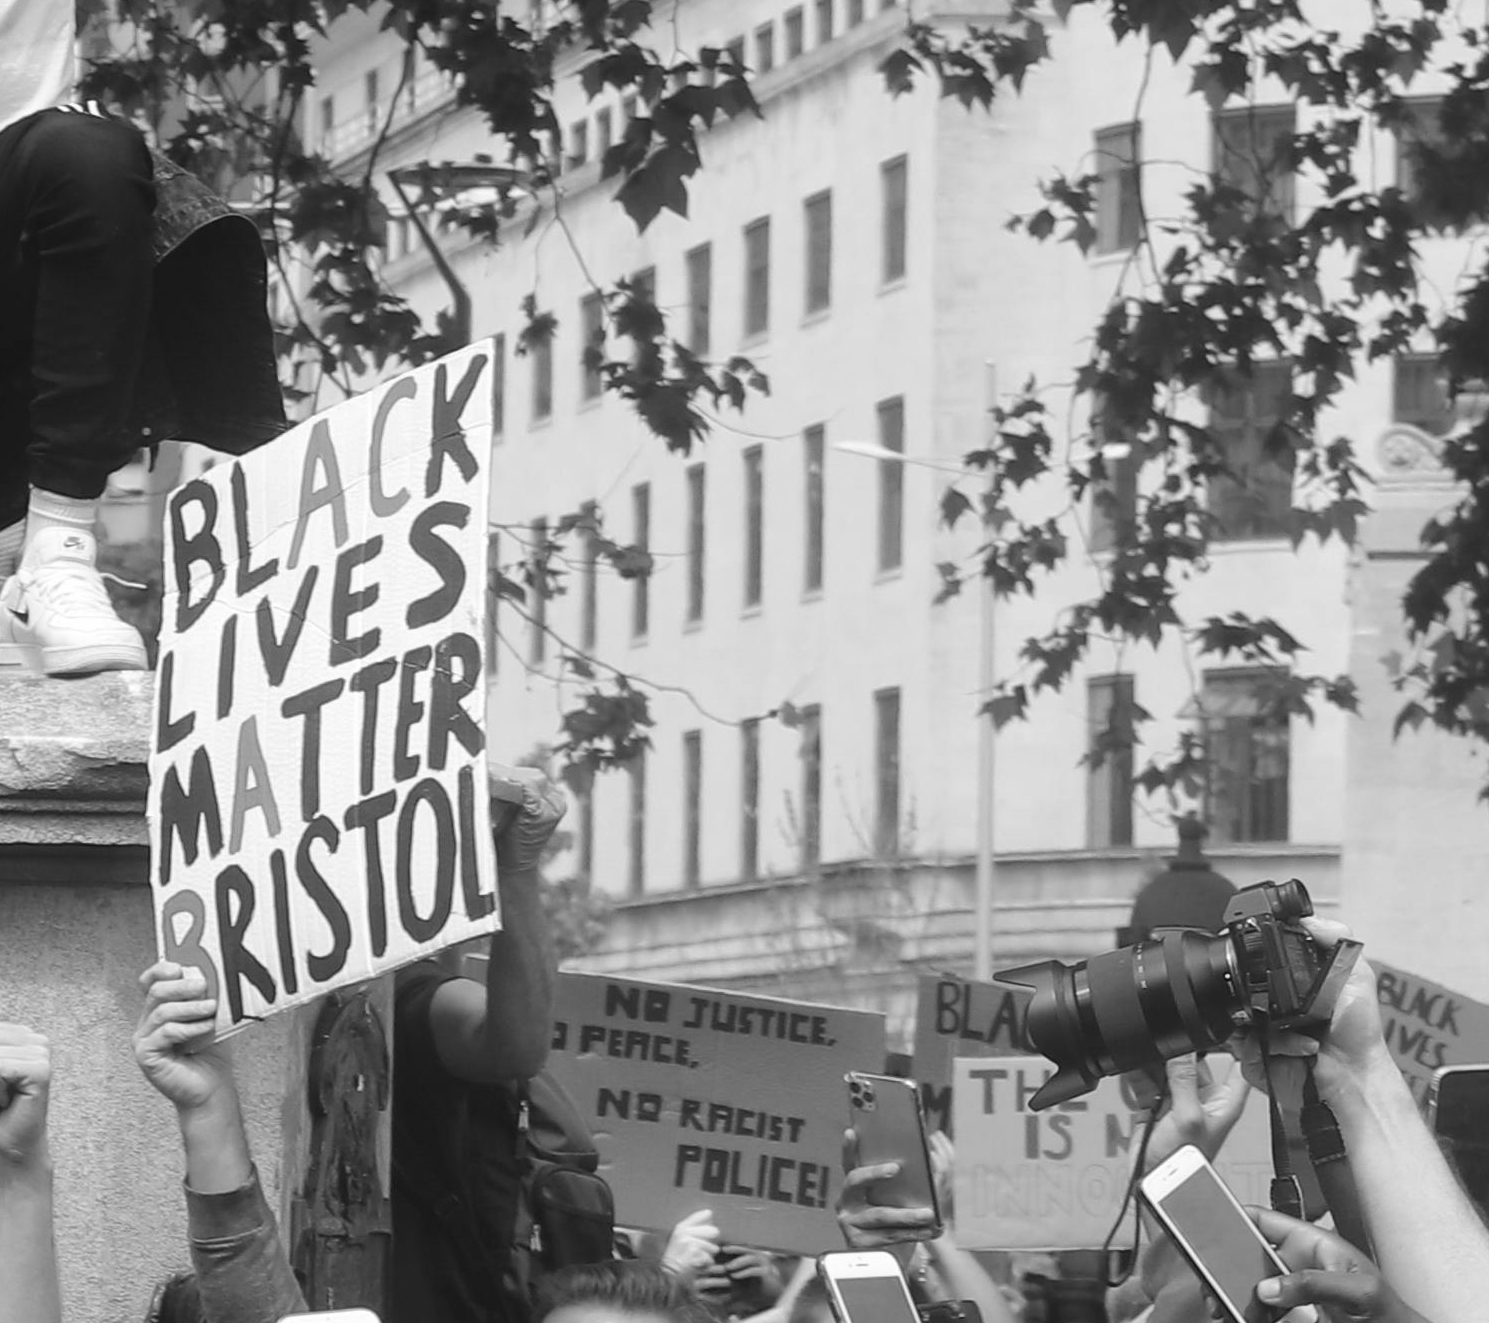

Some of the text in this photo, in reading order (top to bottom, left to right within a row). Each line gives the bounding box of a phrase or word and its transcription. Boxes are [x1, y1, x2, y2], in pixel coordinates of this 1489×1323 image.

[169, 352, 489, 633] BLACK
[156, 500, 471, 754] LIVES
[159, 631, 486, 887] MATTER
[162, 763, 495, 1025] BRISTOL
[606, 984, 838, 1047] NO JUSTICE,
[1377, 971, 1463, 1037] BLACK
[580, 1024, 699, 1068] PEACE,
[1384, 1018, 1447, 1070] IVES
[596, 1087, 806, 1143] NO RACIST
[1025, 1113, 1073, 1160] IS
[674, 1143, 830, 1209] POLICE!
